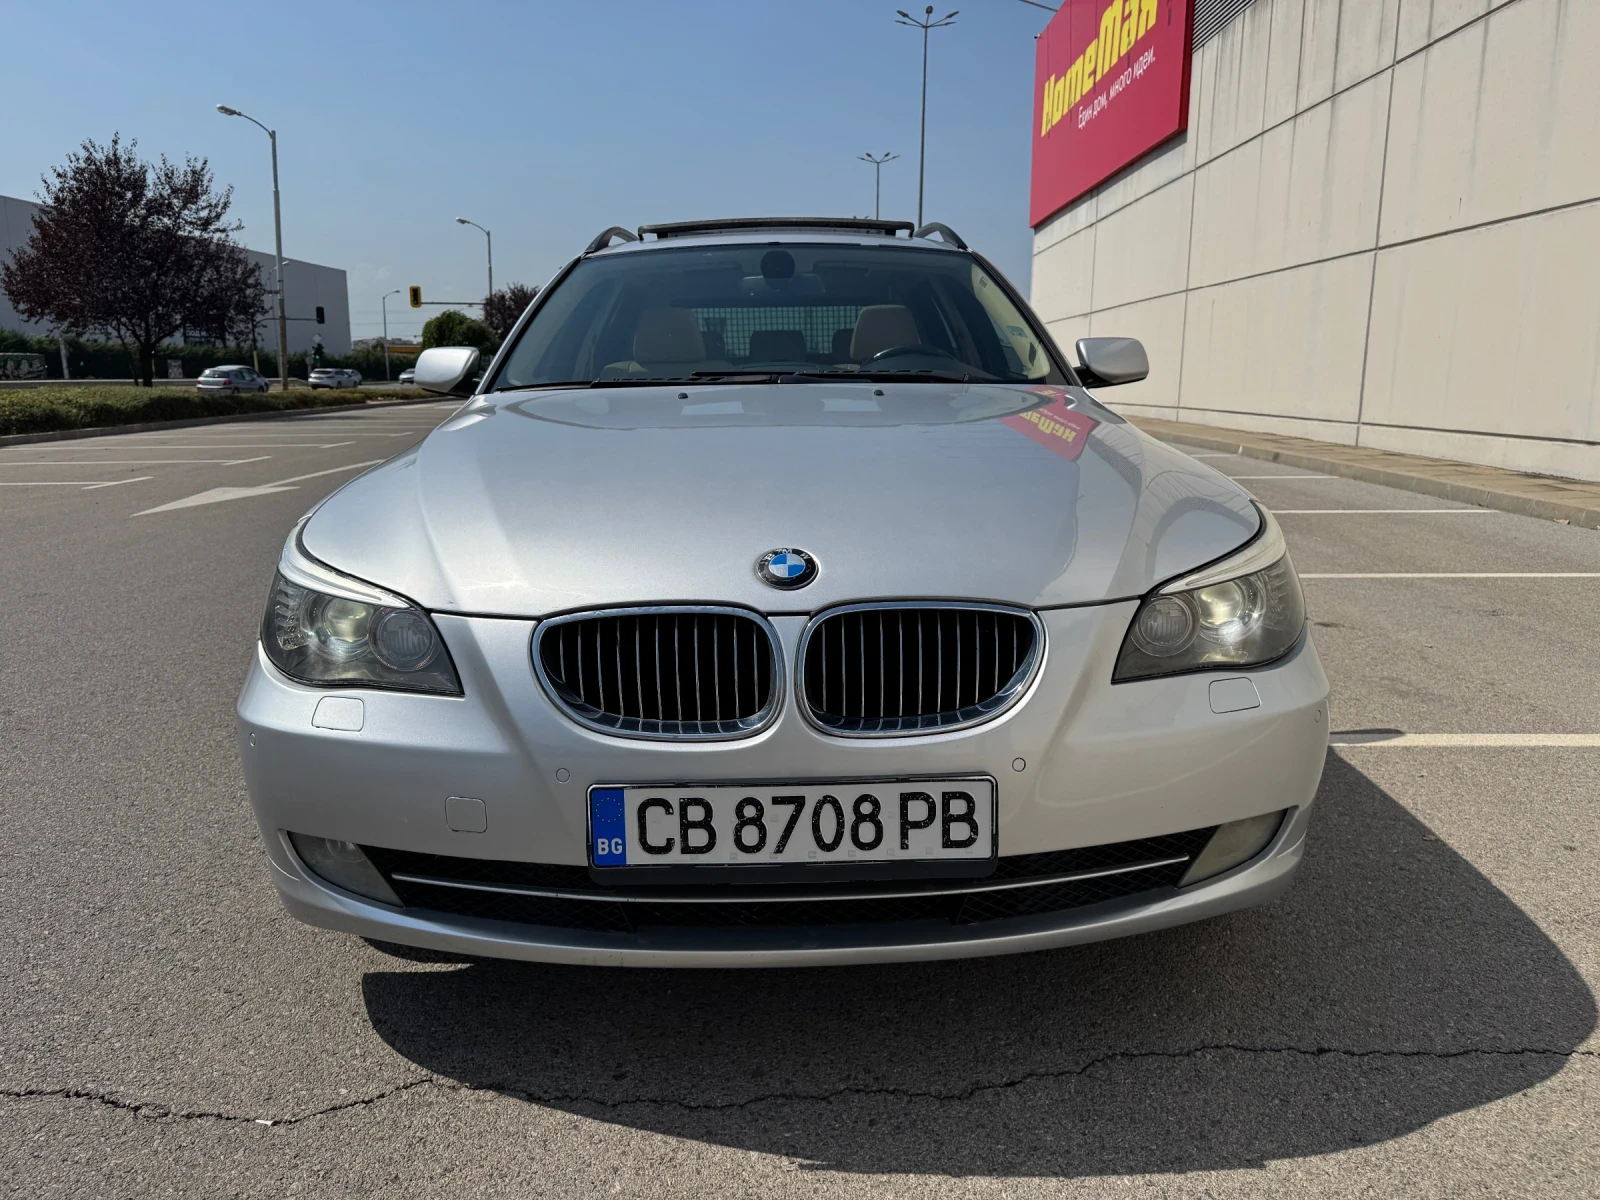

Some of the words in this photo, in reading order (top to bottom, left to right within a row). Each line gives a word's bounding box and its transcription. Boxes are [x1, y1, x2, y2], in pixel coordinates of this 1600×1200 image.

[1078, 104, 1093, 130] Един
[1093, 91, 1108, 119] дом,
[1109, 67, 1132, 101] много
[762, 548, 811, 561] BMW
[637, 797, 717, 855] CB
[733, 793, 884, 854] 8708
[900, 791, 979, 850] PB
[597, 838, 623, 855] BG
